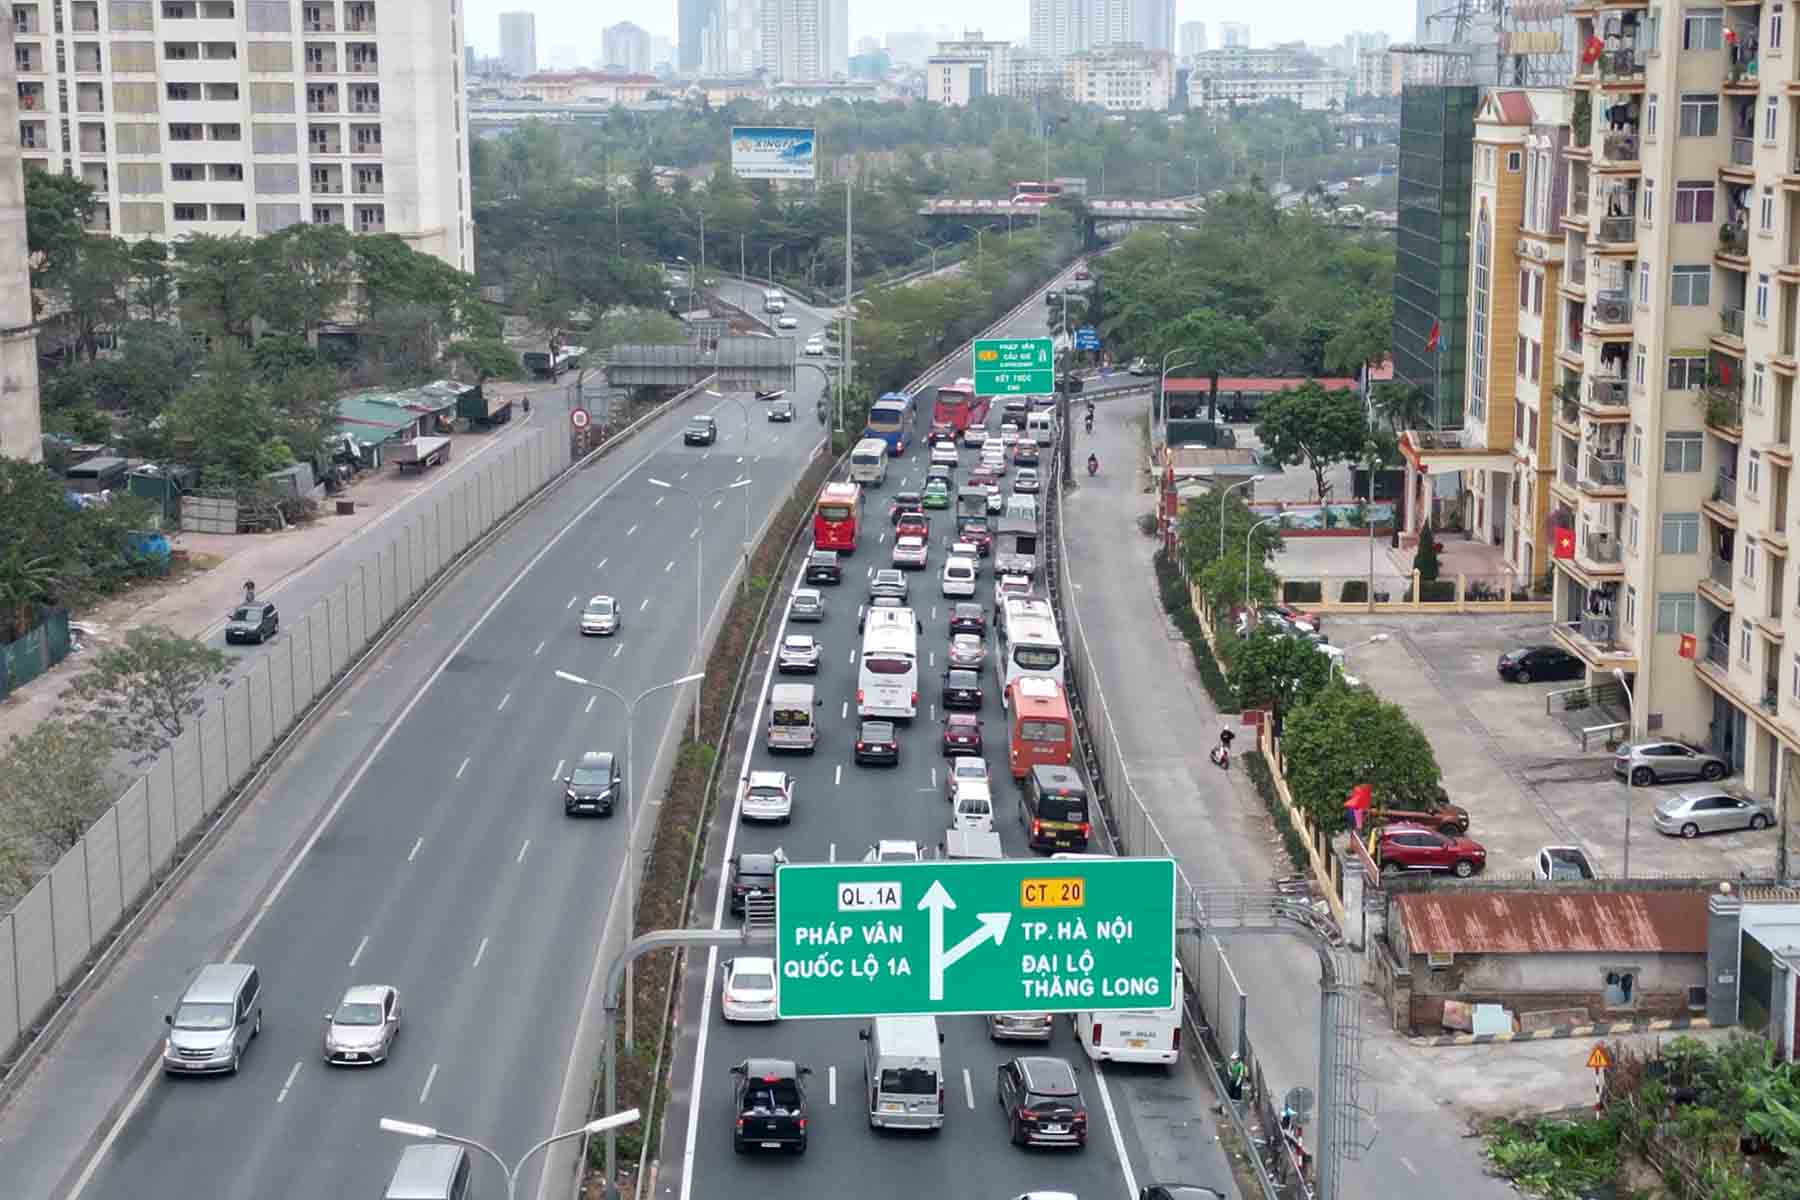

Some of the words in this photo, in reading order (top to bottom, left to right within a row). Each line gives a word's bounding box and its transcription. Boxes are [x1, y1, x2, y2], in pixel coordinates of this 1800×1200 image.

[795, 921, 853, 945] PHÁP
[862, 920, 903, 944] VÂN
[1096, 915, 1133, 944] NỘI
[784, 951, 844, 978] QUỐC
[851, 952, 879, 982] LỘ
[887, 957, 911, 976] 1A
[1021, 953, 1058, 977] ĐẠI
[1066, 948, 1095, 976] LỘ
[1021, 974, 1095, 998] THĂNG
[1102, 977, 1159, 997] LONG
